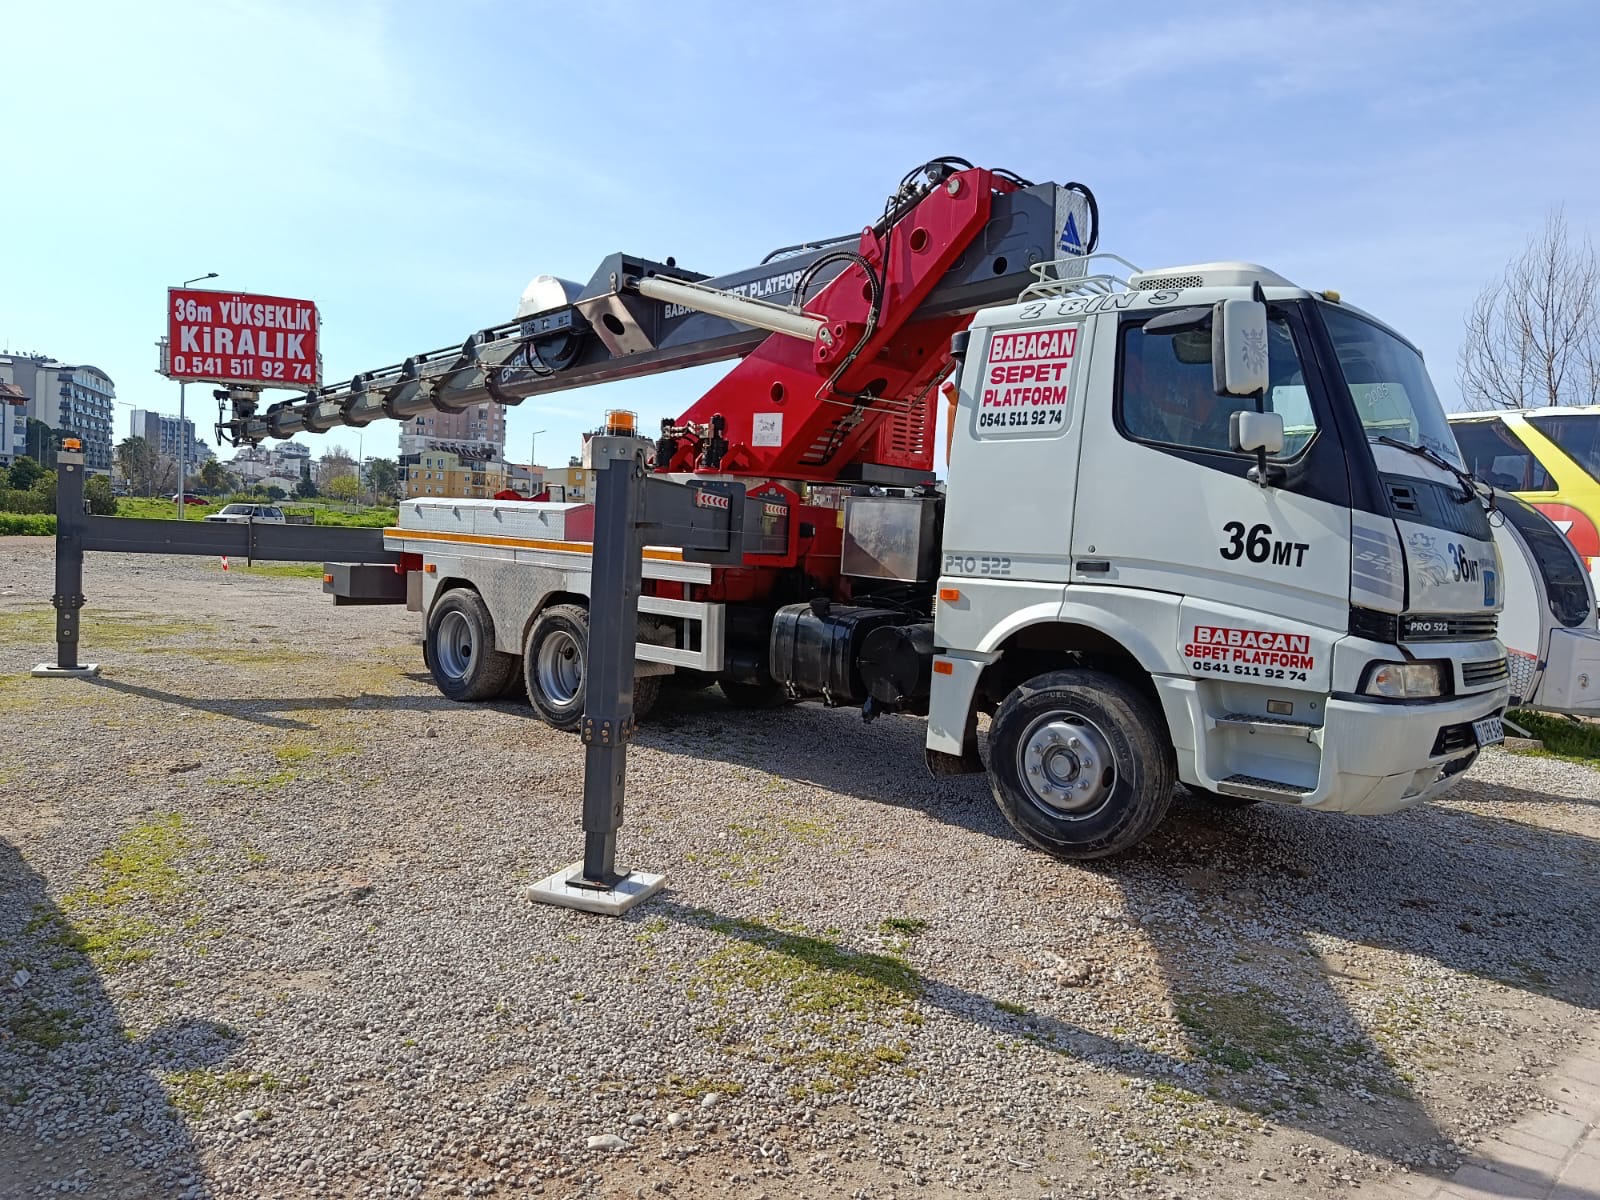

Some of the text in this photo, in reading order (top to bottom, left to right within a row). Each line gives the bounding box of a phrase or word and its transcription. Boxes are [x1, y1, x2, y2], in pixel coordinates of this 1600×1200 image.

[175, 297, 312, 331] 36m YÜKSEKLİK
[1020, 303, 1047, 319] 2
[992, 331, 1075, 361] BABACAN
[174, 356, 311, 380] 0.541 511 92 74
[990, 363, 1067, 384] SEPET
[983, 386, 1067, 407] PLATFORM
[980, 410, 1062, 427] 0541 511 92 74
[945, 555, 976, 573] PRO
[1411, 622, 1448, 631] PRO 522
[1197, 627, 1307, 653] BABACAN
[1184, 644, 1314, 670] SEPET PLATFORM
[1193, 661, 1307, 682] 0541 511 92 74
